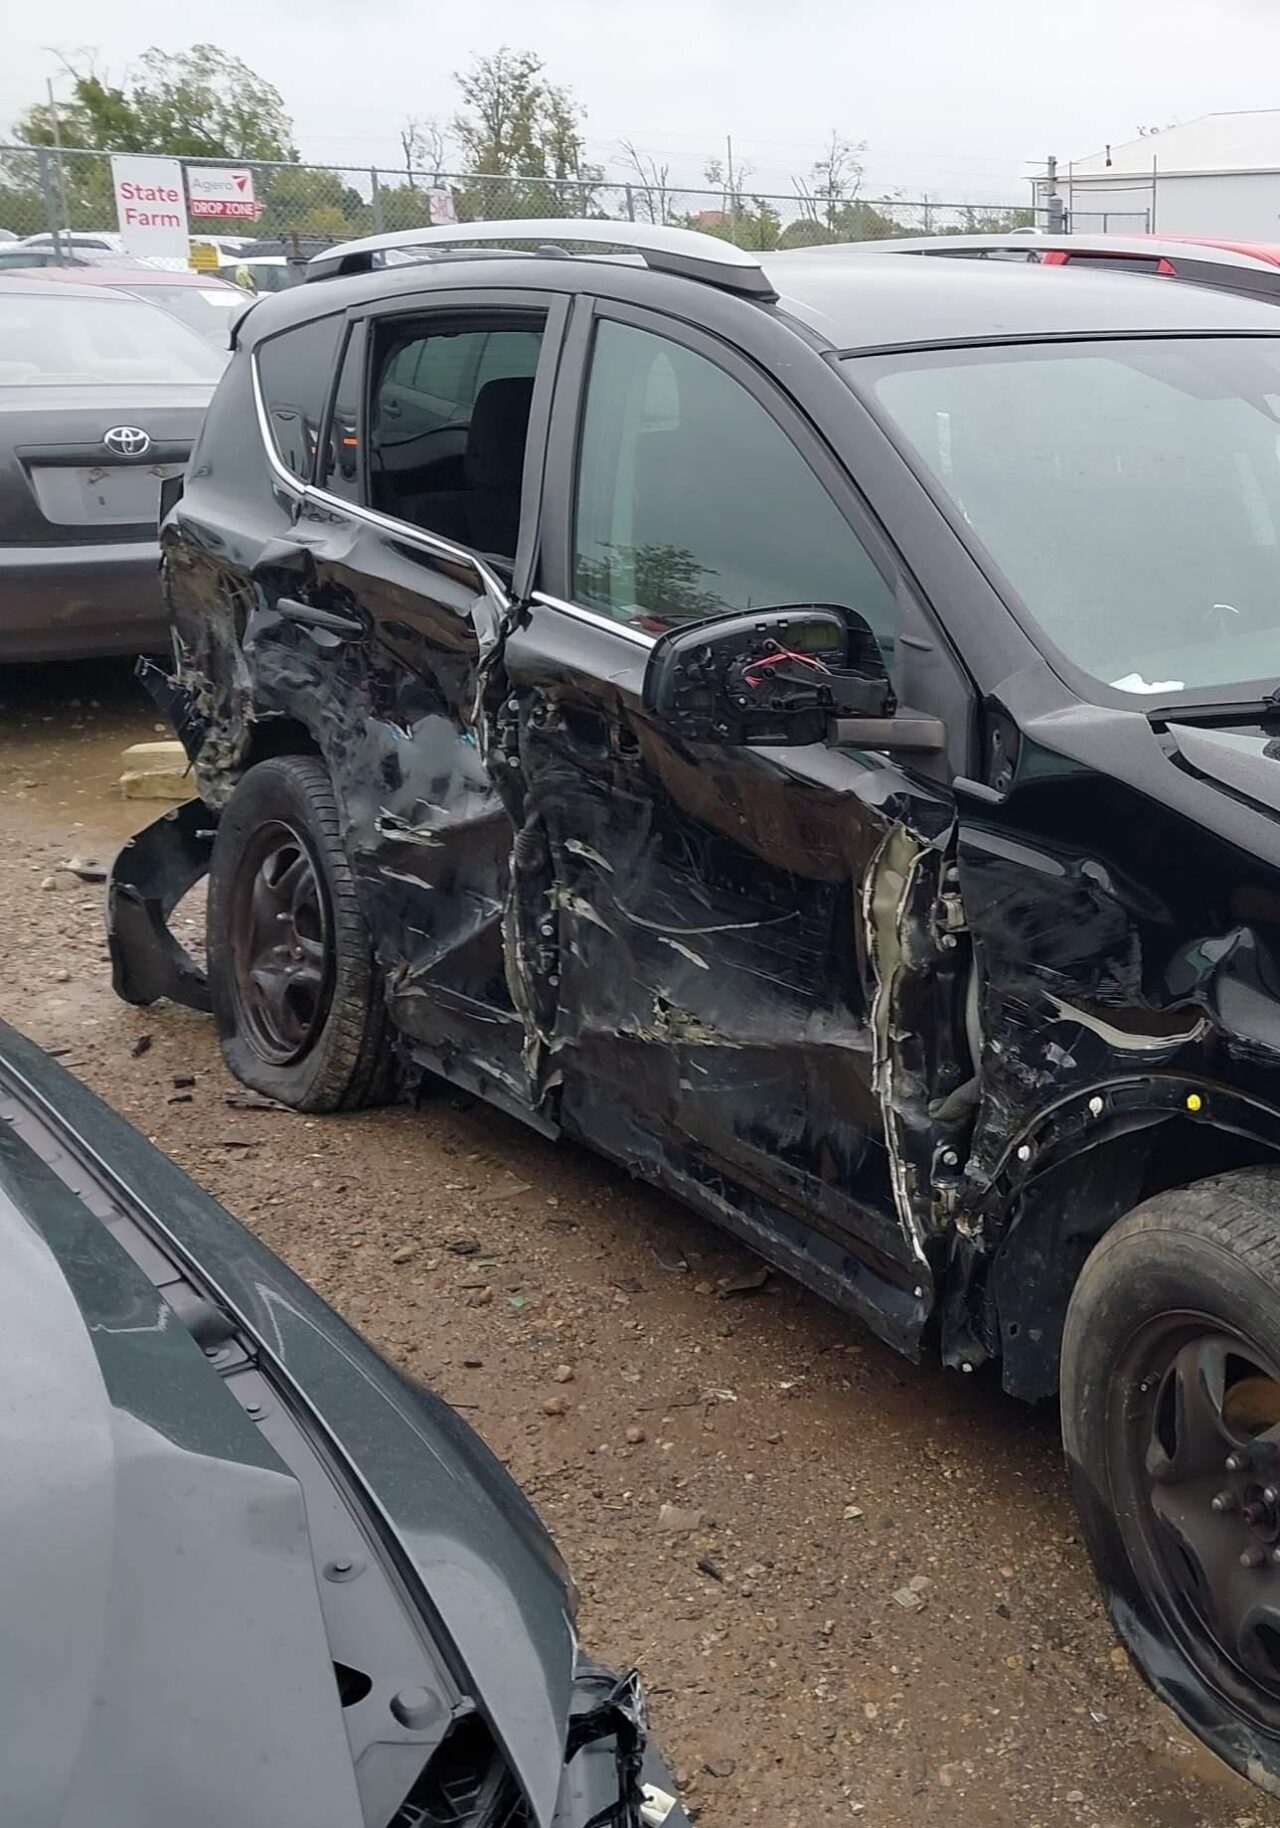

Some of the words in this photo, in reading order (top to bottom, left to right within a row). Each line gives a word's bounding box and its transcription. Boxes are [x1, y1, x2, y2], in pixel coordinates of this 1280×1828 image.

[120, 182, 179, 202] State
[124, 207, 181, 227] Farm
[192, 201, 224, 214] DROP
[225, 203, 255, 216] ZONE
